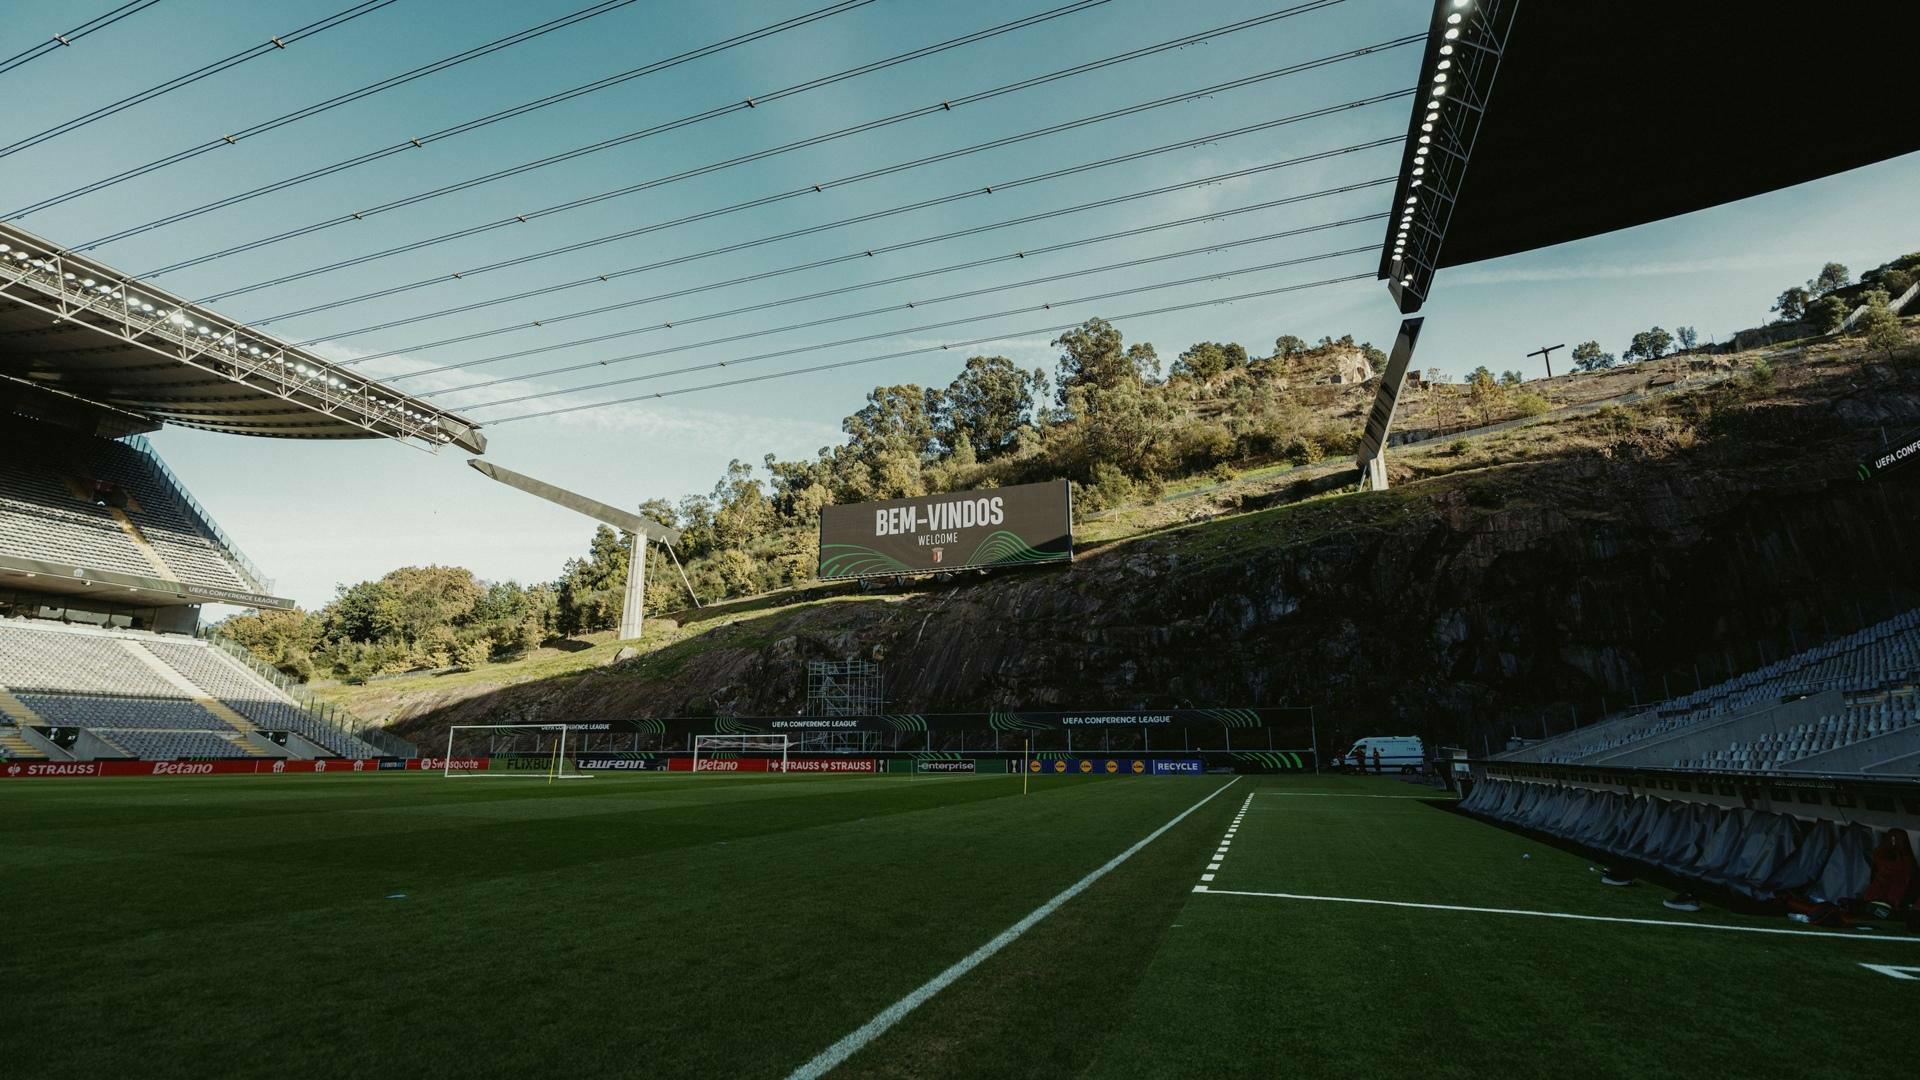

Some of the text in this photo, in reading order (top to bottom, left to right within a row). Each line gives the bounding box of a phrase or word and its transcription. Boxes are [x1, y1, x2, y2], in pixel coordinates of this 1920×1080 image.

[1875, 454, 1896, 469] UEFA
[876, 497, 1003, 536] BEM-VINDOS
[918, 532, 958, 546] WELCOME
[189, 586, 279, 605] UEFA CONFERENCE LEAGUE
[789, 720, 831, 728] CONFERENCE
[1062, 715, 1170, 725] UEFA CONFERENCE LEAGUE
[27, 764, 95, 775] STRAUSS
[152, 761, 213, 775] Betano
[697, 759, 738, 771] Betano
[780, 761, 872, 771] STRAUSS STRAUSS
[921, 761, 974, 771] enterprise
[1157, 762, 1199, 771] RECYCLE
